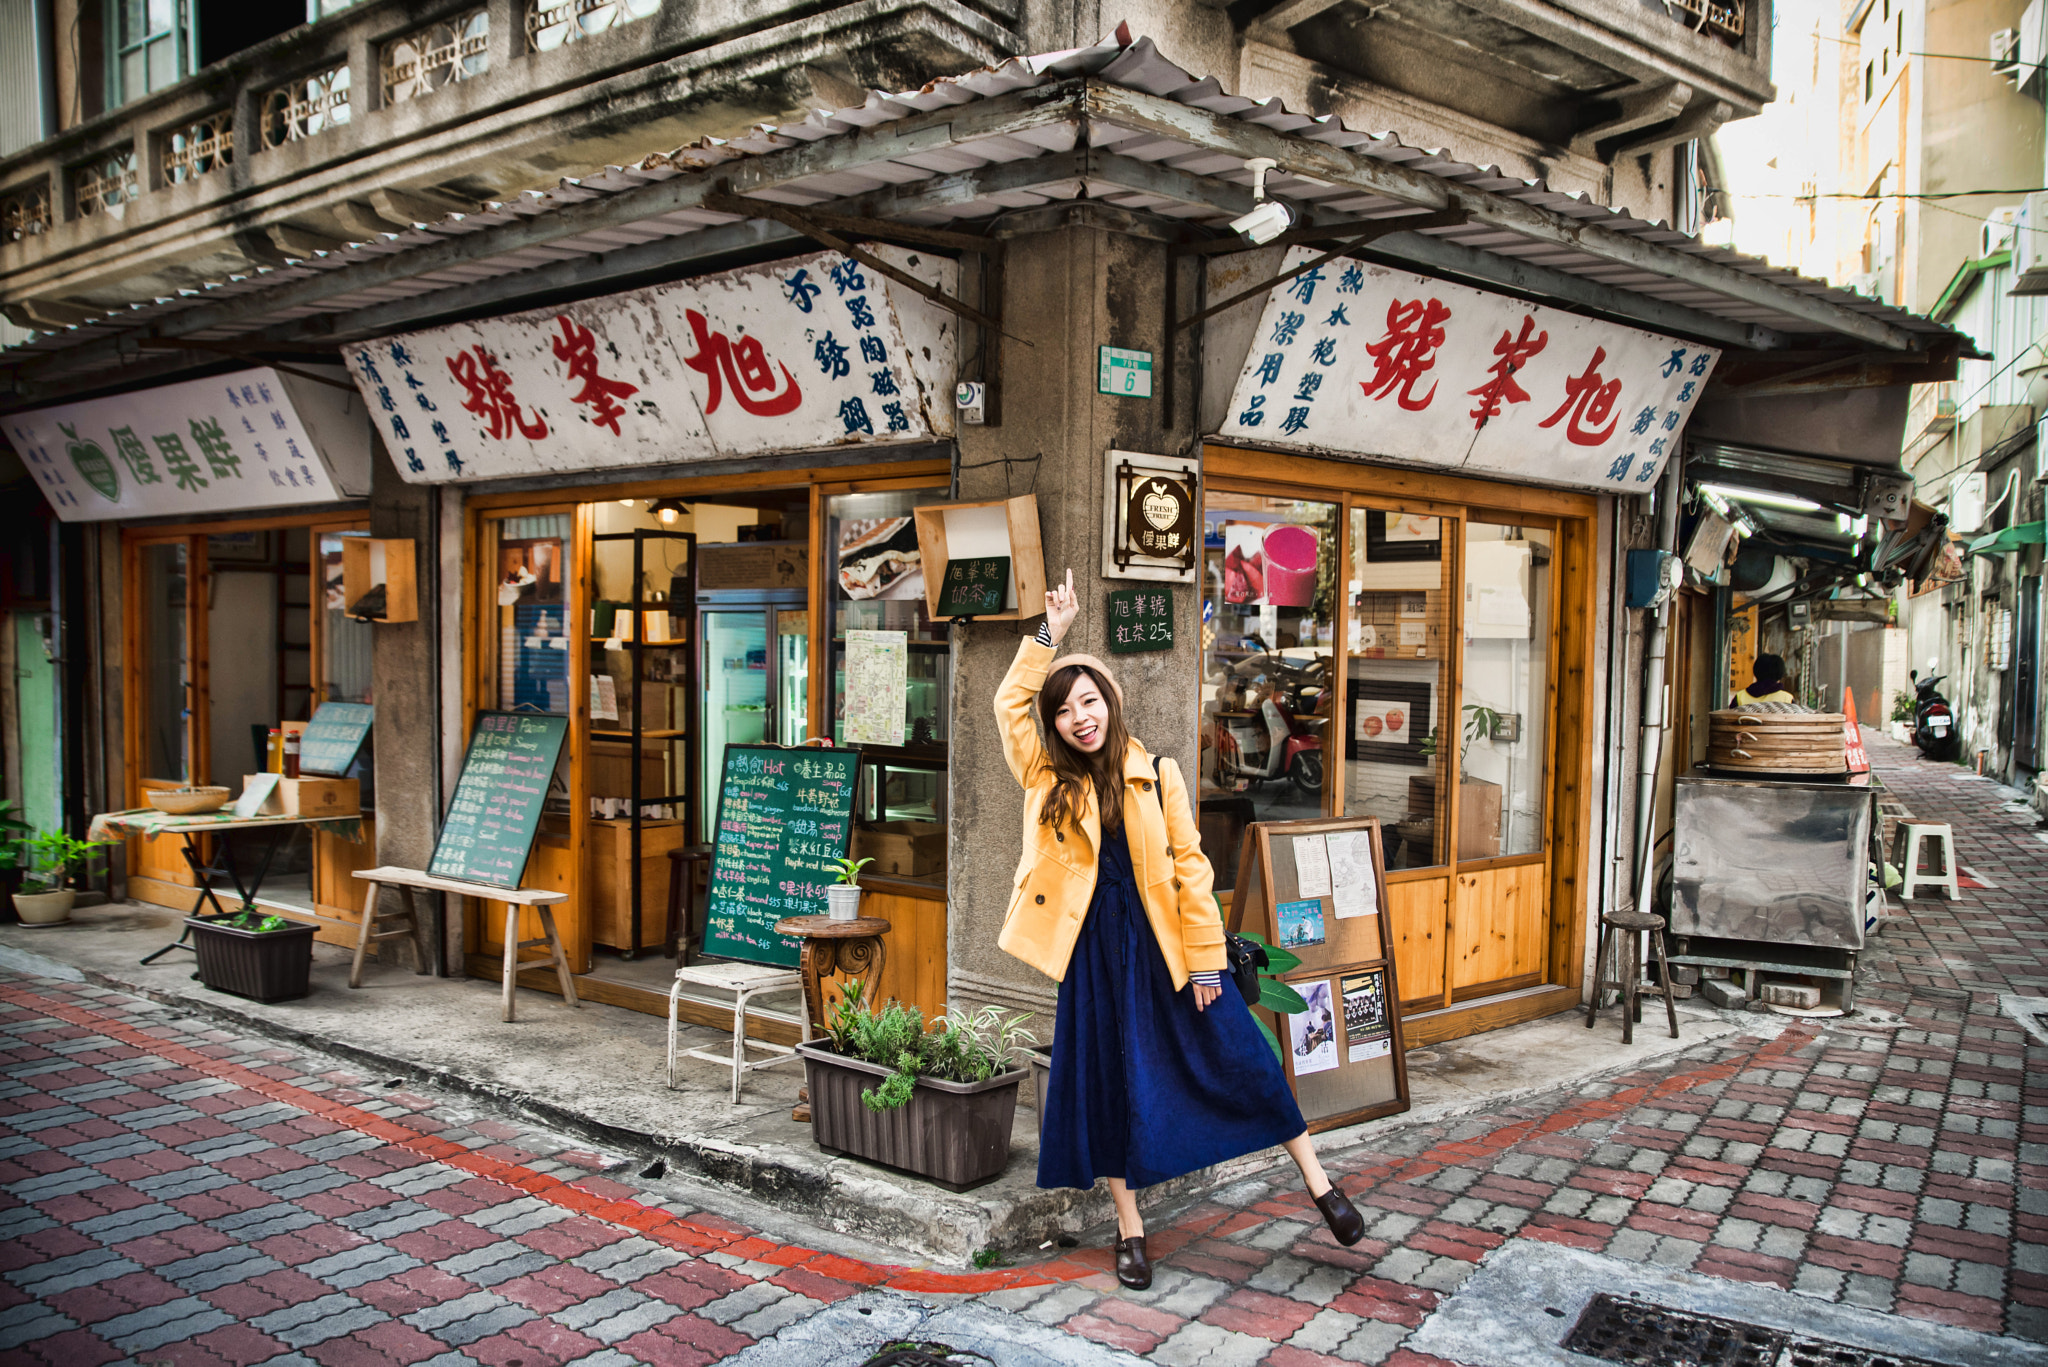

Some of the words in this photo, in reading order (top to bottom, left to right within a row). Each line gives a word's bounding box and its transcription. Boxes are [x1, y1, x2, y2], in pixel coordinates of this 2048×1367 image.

[1124, 371, 1136, 392] 6
[1149, 505, 1173, 514] FRESH
[763, 759, 786, 776] Hot
[832, 848, 844, 859] 60
